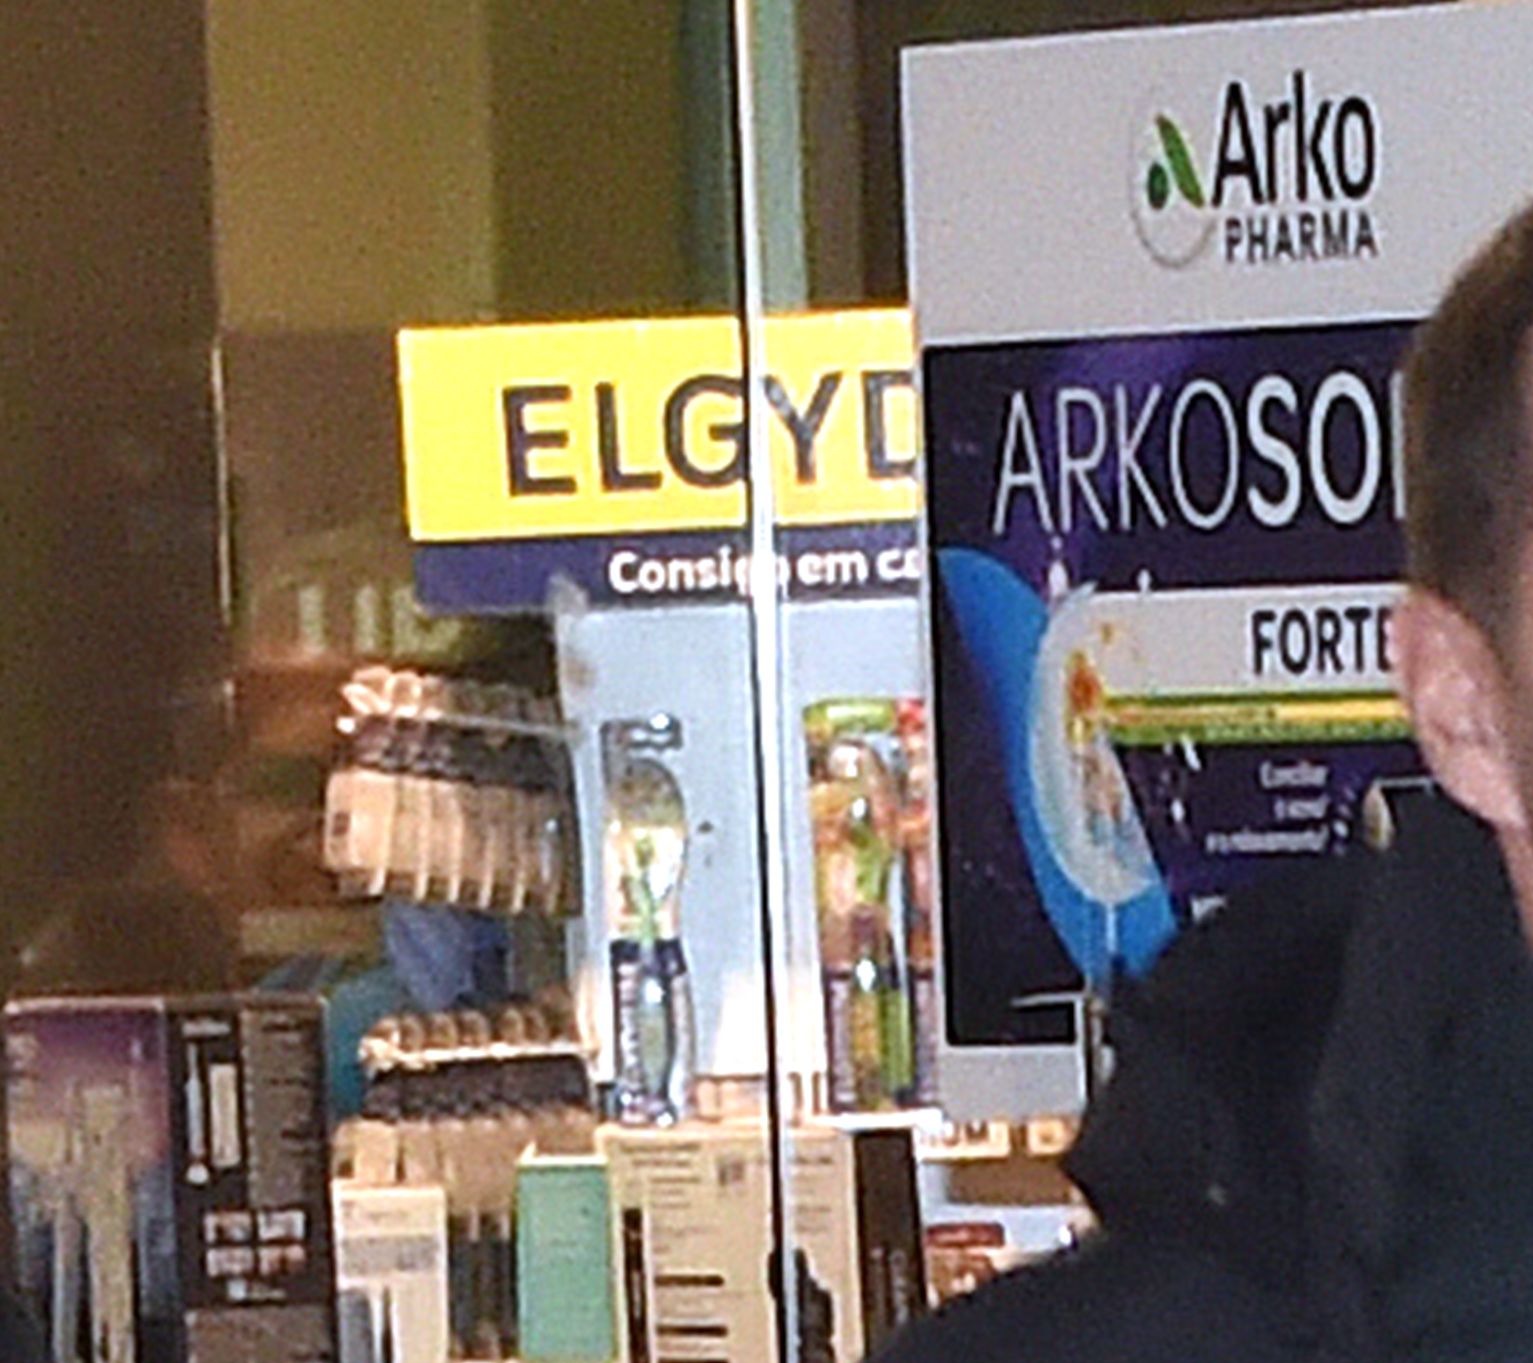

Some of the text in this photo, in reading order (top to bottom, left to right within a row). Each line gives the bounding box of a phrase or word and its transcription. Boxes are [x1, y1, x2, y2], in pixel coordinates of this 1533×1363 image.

[1211, 69, 1376, 207] Arko
[1224, 211, 1379, 263] PHARMA
[797, 550, 869, 587] em
[1251, 606, 1394, 675] FORTE
